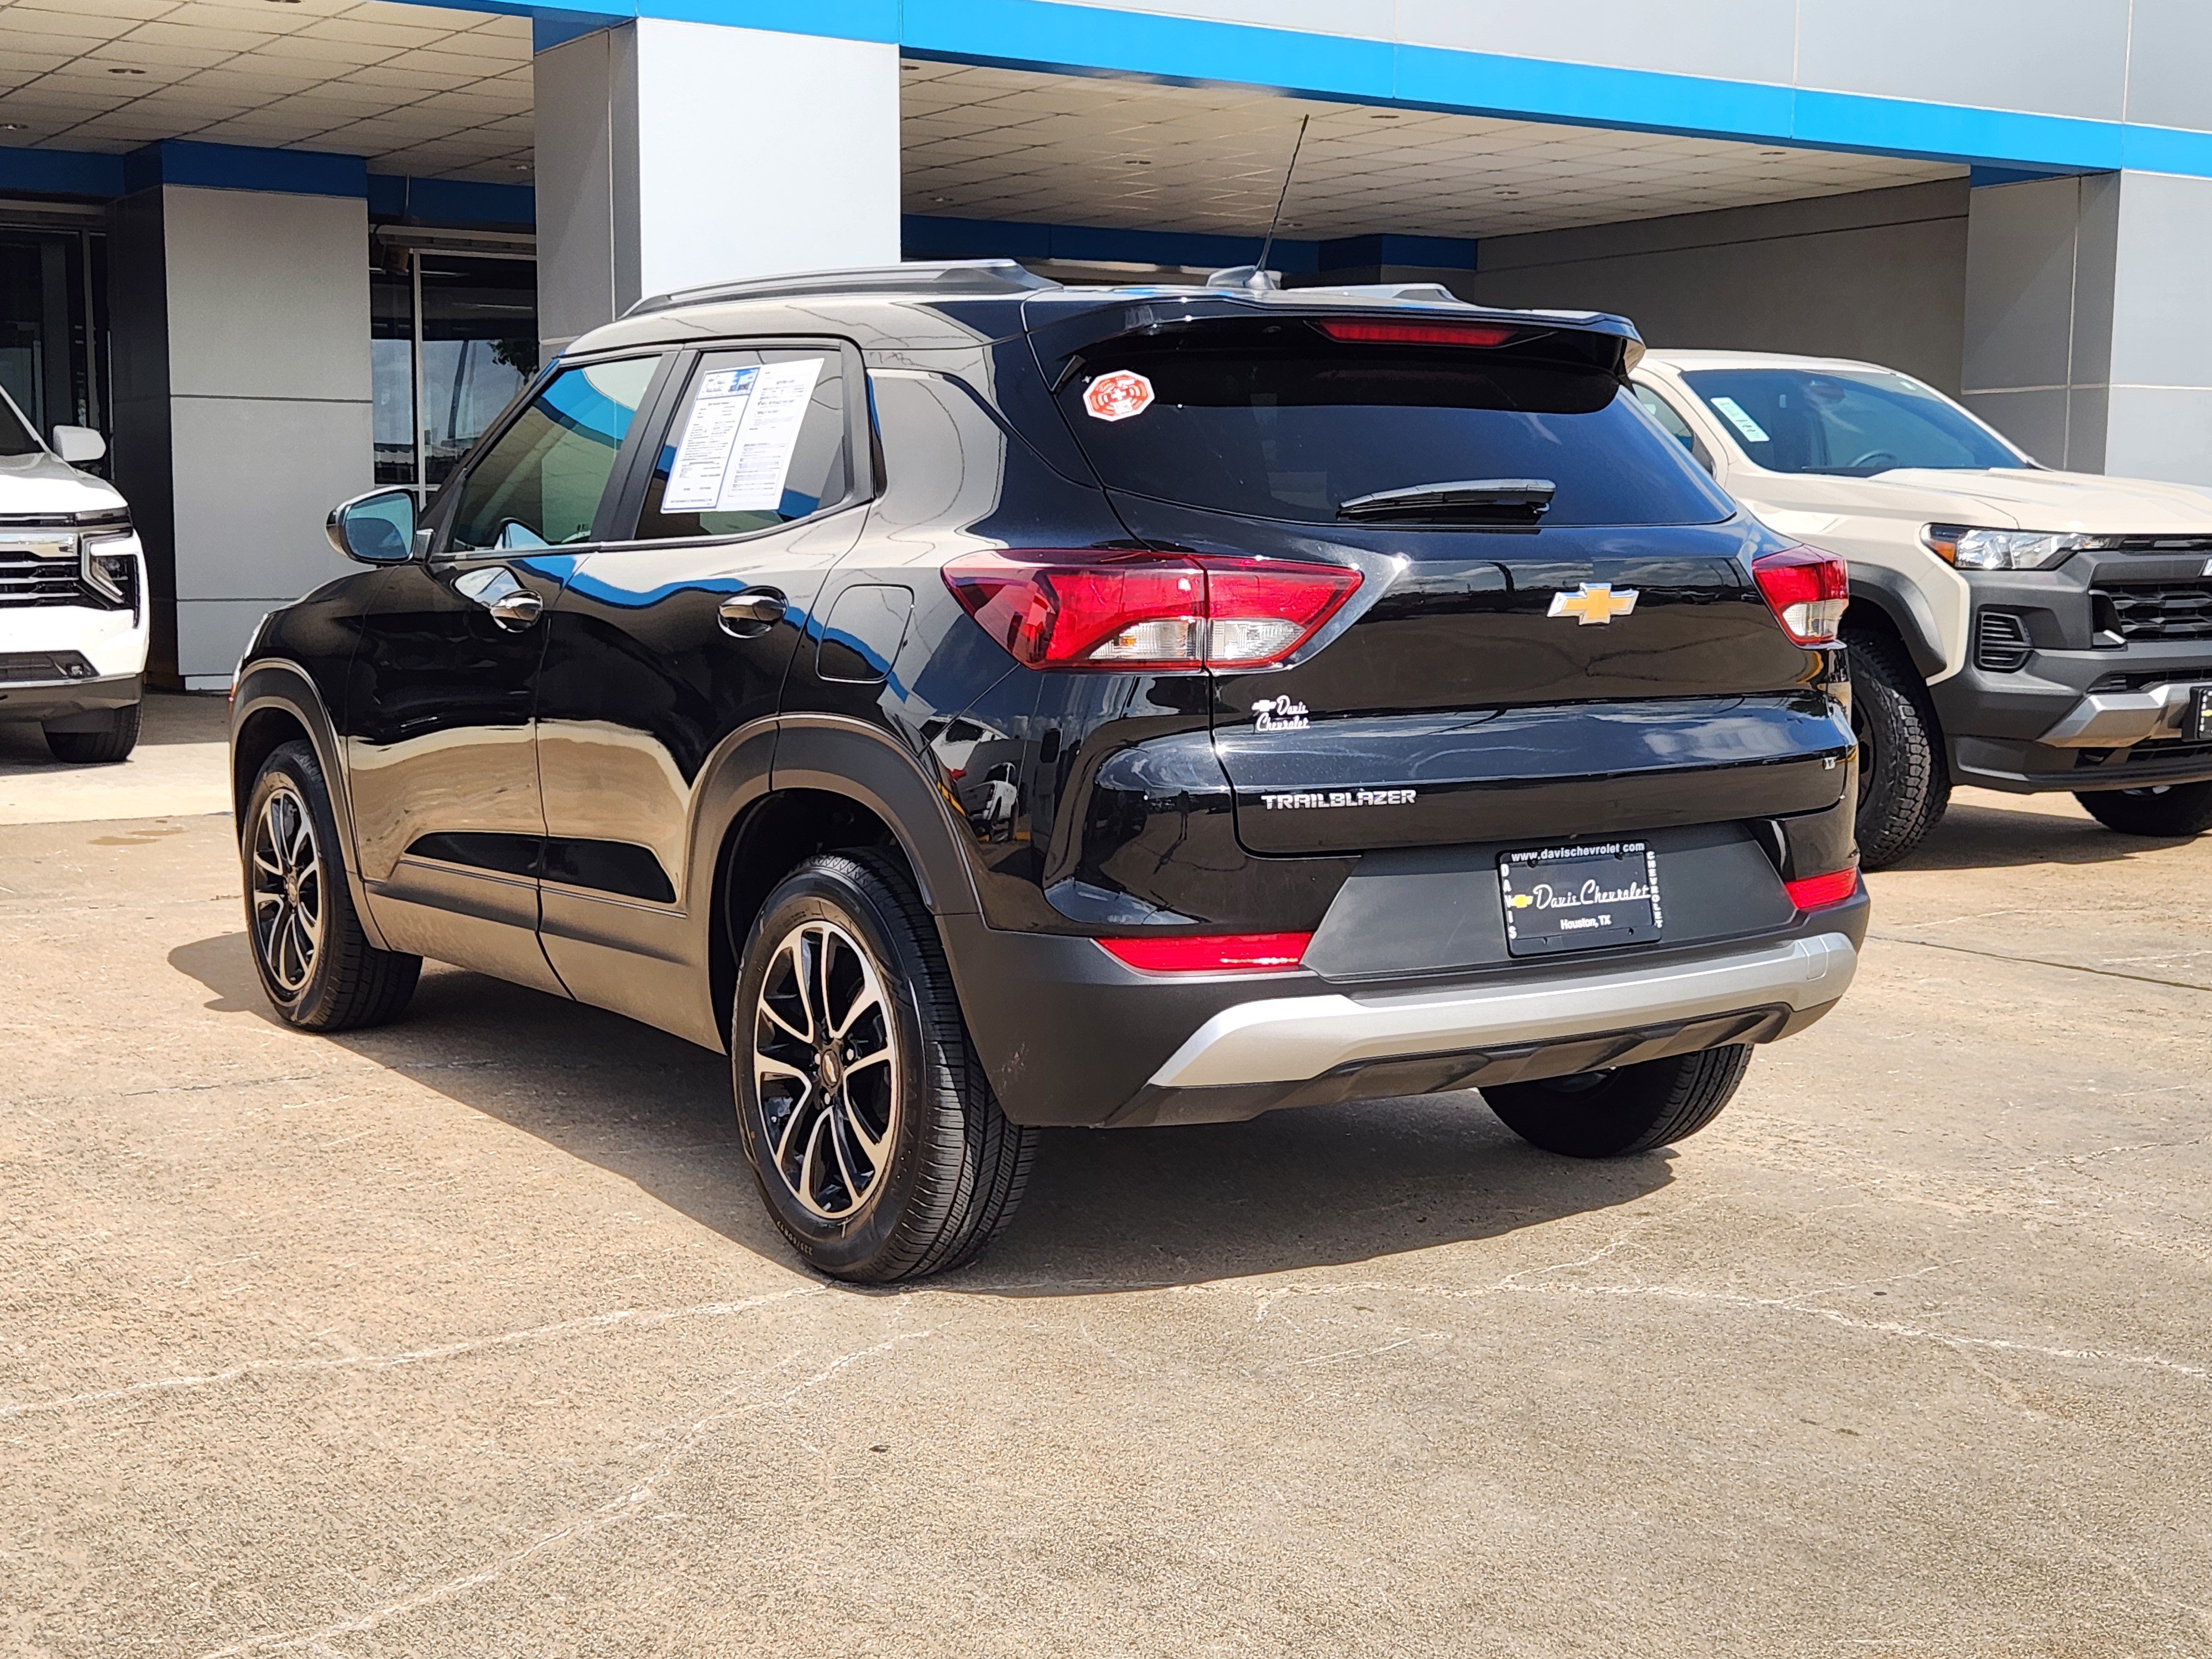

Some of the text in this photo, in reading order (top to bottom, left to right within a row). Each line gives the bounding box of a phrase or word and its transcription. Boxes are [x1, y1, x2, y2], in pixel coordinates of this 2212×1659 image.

[1276, 695, 1309, 716] Davis
[1255, 712, 1311, 732] Chevrolet
[1261, 790, 1416, 810] TRAILBLAZER
[1511, 843, 1645, 862] www.davischevroletcom
[1533, 879, 1651, 909] Davis Chevrolet
[1647, 851, 1663, 928] CHEVROLET
[1501, 863, 1517, 939] DAVIS
[1560, 914, 1611, 930] Houston, TX
